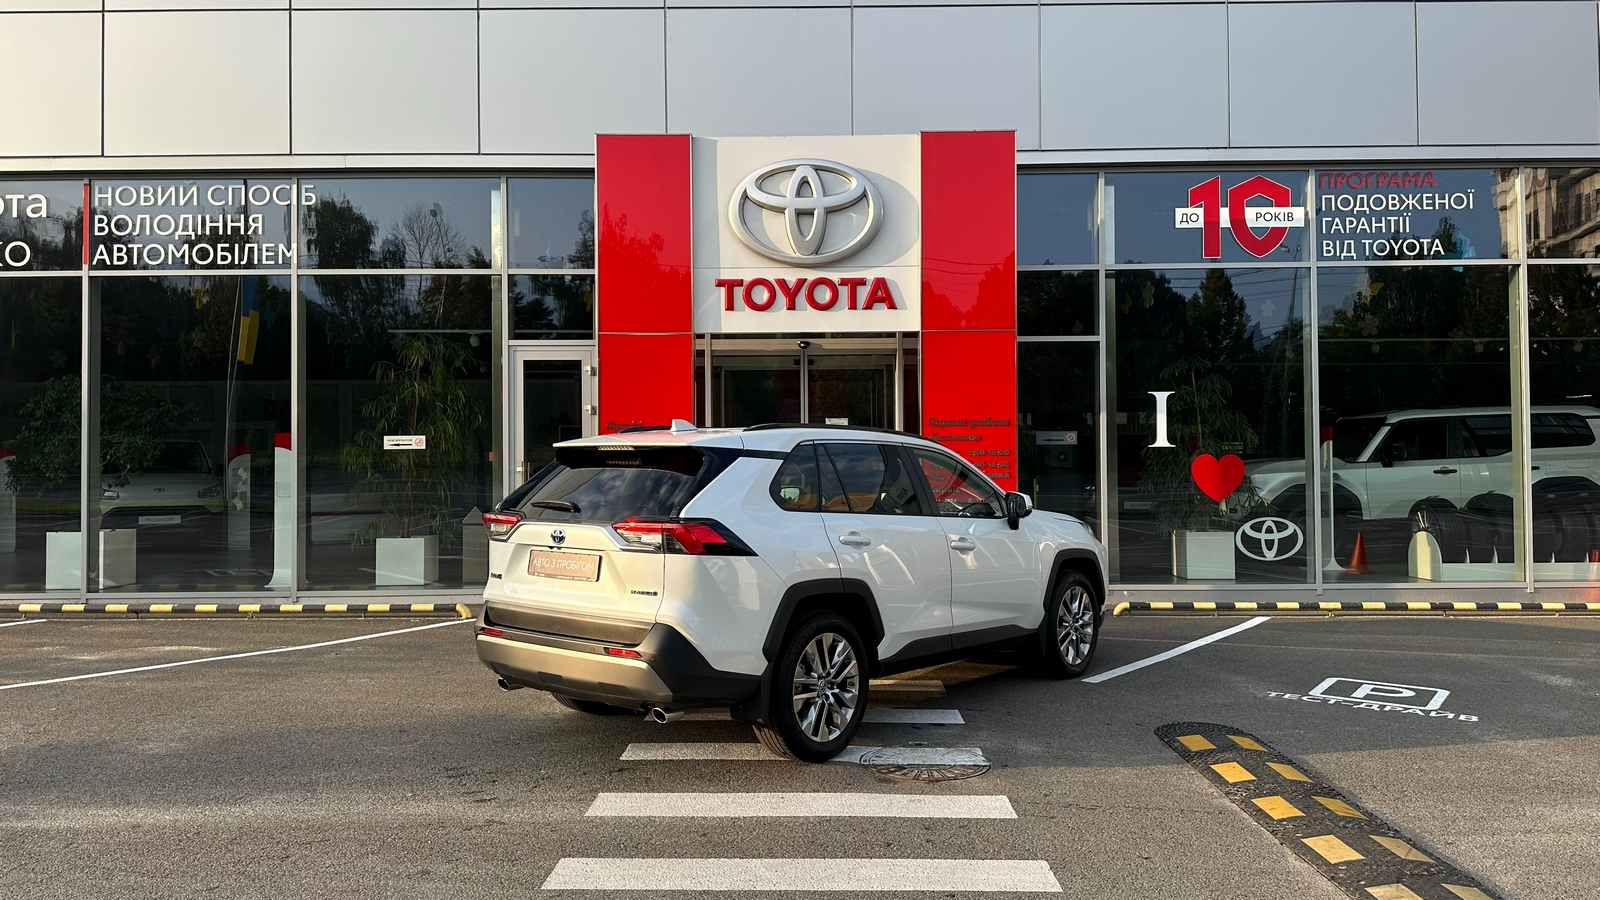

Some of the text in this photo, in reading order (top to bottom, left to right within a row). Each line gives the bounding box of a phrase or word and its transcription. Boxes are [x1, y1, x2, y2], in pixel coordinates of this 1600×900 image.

[1319, 171, 1438, 189] ПРОГРАМА
[94, 179, 199, 207] НОВИЙ
[1321, 189, 1475, 214] ПОДОВЖЕНОЇ
[94, 213, 264, 240] ВОЛОДІННЯ
[1180, 174, 1295, 259] ДО 10 РОКІВ
[1321, 213, 1412, 234] ГАРАНТІЇ
[92, 243, 298, 266] АВТОМОБІЛЕМ
[1322, 239, 1445, 260] ВІД TOYOTA
[715, 277, 897, 312] TOYOTA
[930, 418, 966, 427] Години
[1147, 391, 1177, 447] I
[532, 557, 551, 568] АВТО
[556, 559, 595, 571] ПРОБІГОМ
[1350, 684, 1416, 698] P
[1267, 691, 1480, 722] ТЕСТ-ДРАЙВ
